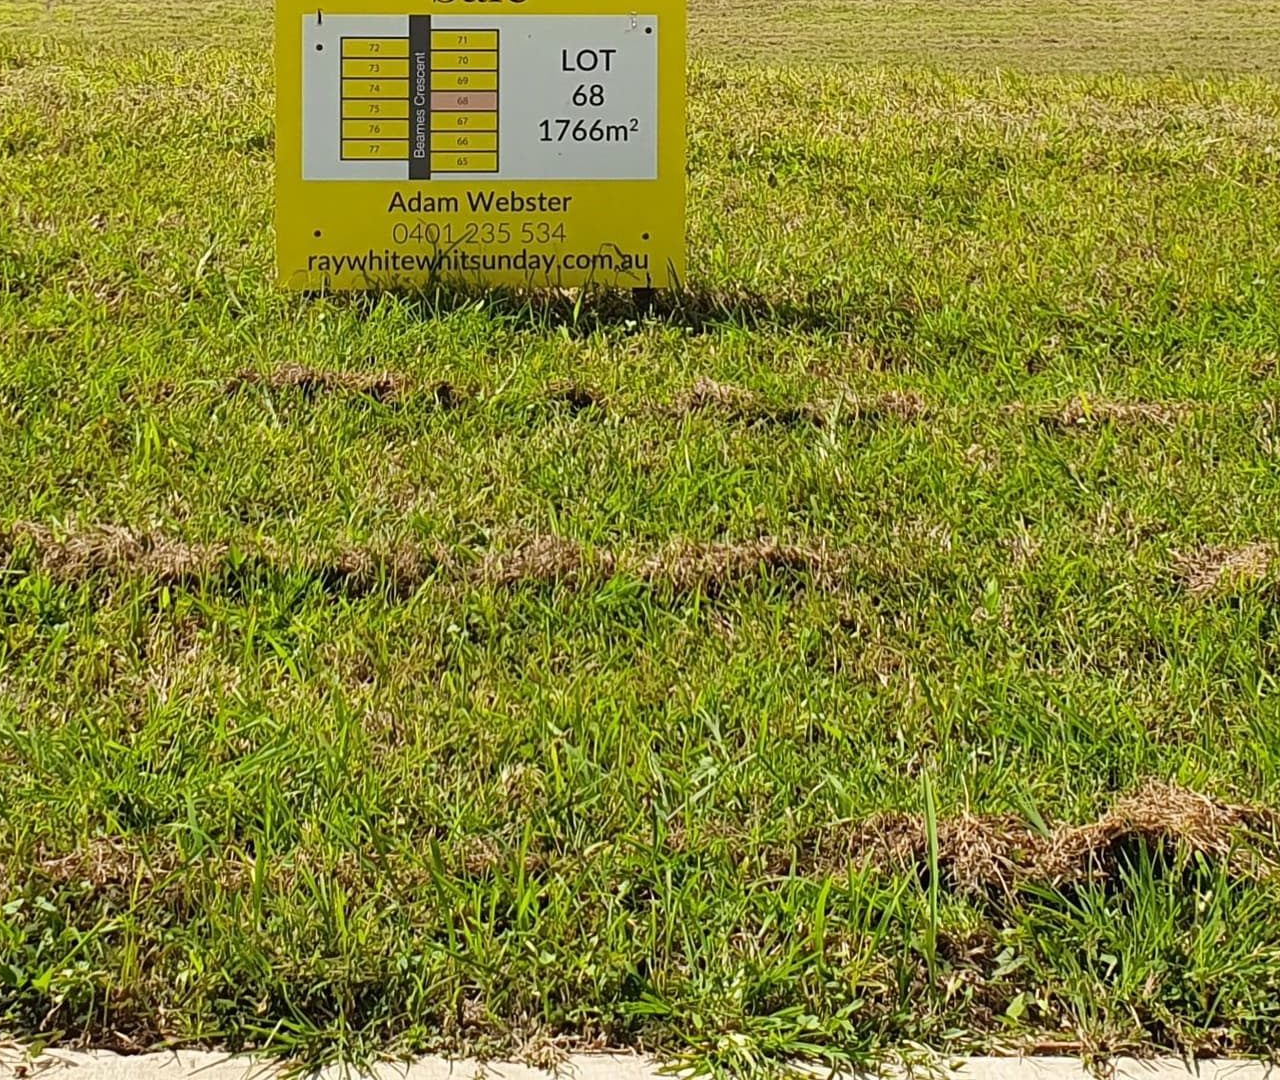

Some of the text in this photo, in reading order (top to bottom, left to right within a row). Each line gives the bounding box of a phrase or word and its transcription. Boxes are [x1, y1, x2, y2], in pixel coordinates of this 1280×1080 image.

[457, 35, 468, 45] 71
[369, 43, 380, 53] 72
[457, 55, 468, 65] 70
[562, 49, 617, 71] LOT
[369, 63, 380, 73] 73
[457, 76, 468, 86] 69
[369, 83, 380, 93] 74
[572, 84, 605, 107] 68
[413, 52, 426, 159] Beames Crescent
[457, 96, 468, 106] 68
[369, 104, 380, 114] 75
[457, 116, 468, 126] 67
[369, 124, 380, 134] 76
[457, 136, 468, 146] 66
[369, 144, 380, 154] 77
[457, 156, 468, 166] 65
[388, 191, 573, 213] Adam Webster
[392, 223, 567, 244] 0401 235 534
[308, 249, 649, 274] raywhitewhitsunday.com.au
